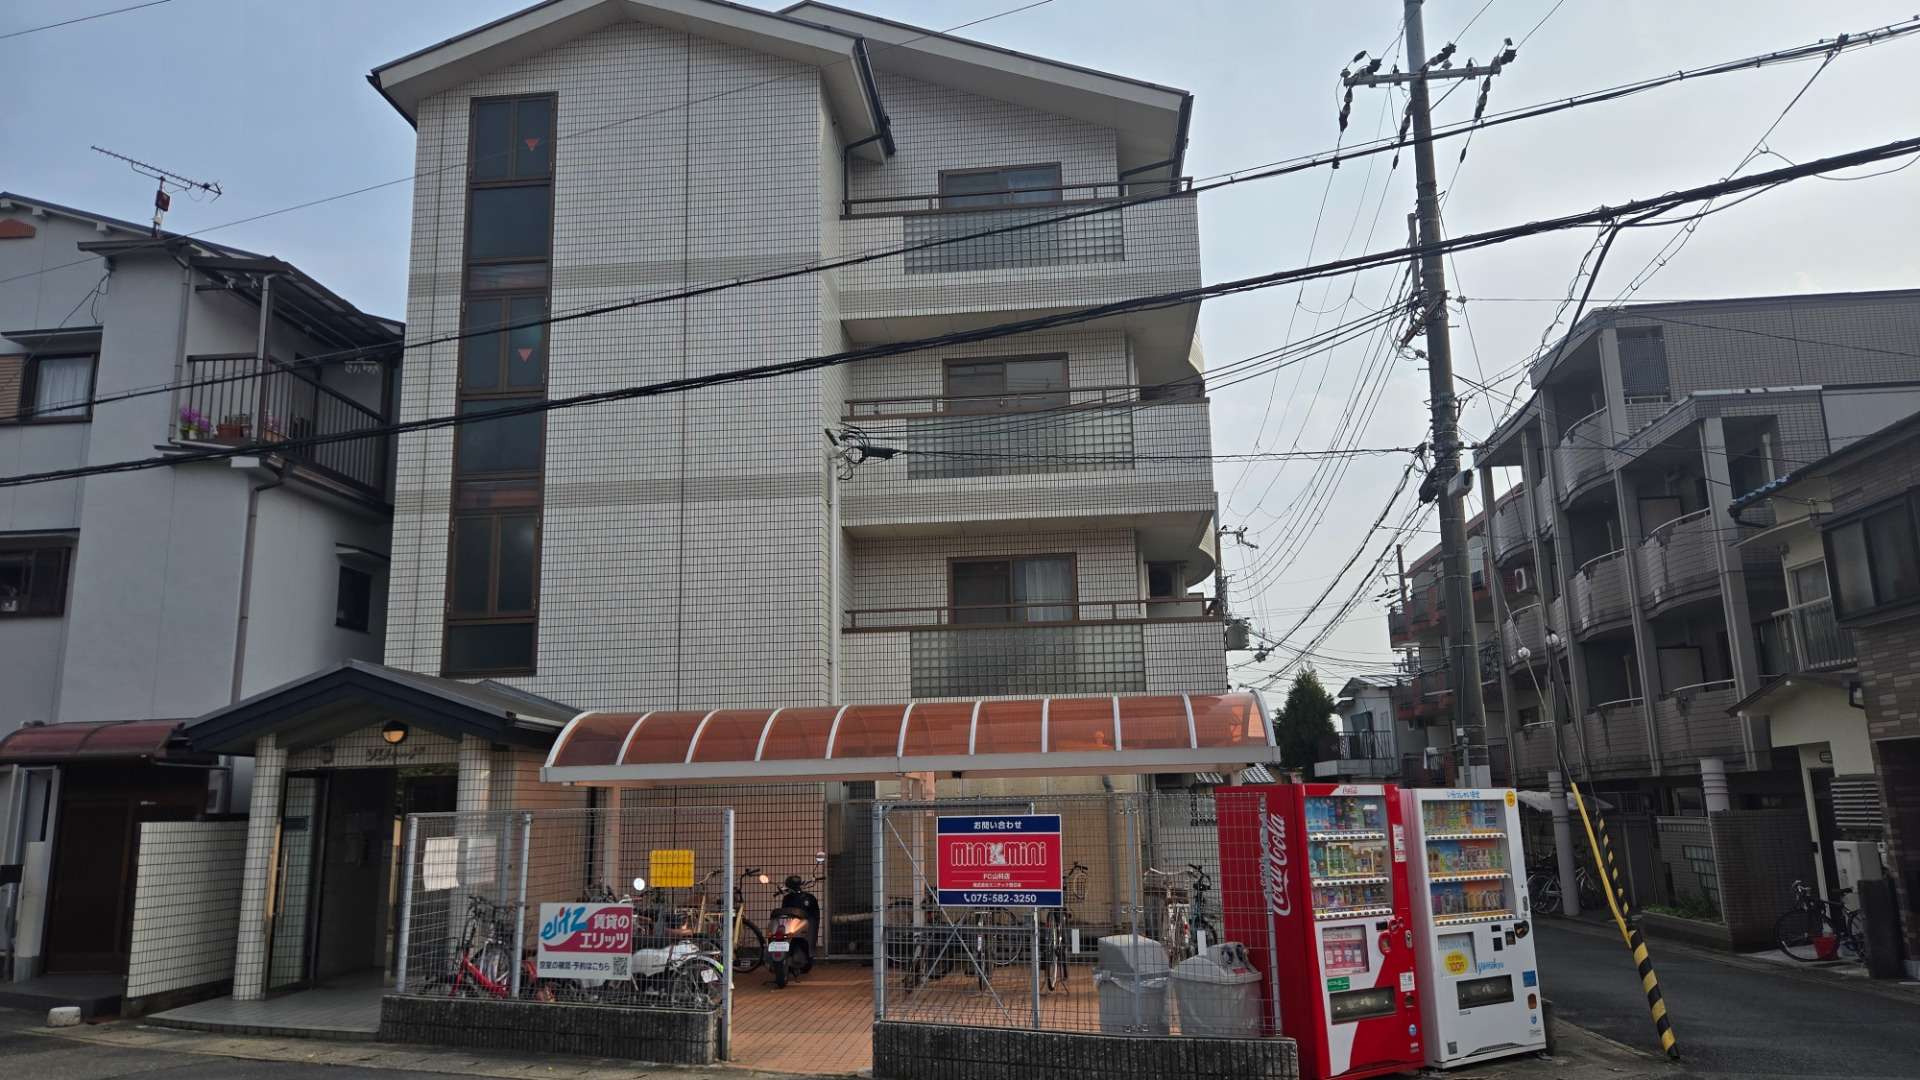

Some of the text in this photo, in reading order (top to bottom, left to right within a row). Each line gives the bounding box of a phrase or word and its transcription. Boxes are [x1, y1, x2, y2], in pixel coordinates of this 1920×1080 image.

[973, 821, 1022, 830] お問い合わせ
[970, 893, 1037, 903] 075-582-3250
[541, 905, 588, 940] elitz
[593, 913, 630, 930] 賃貸の
[579, 932, 629, 949] エリッツ
